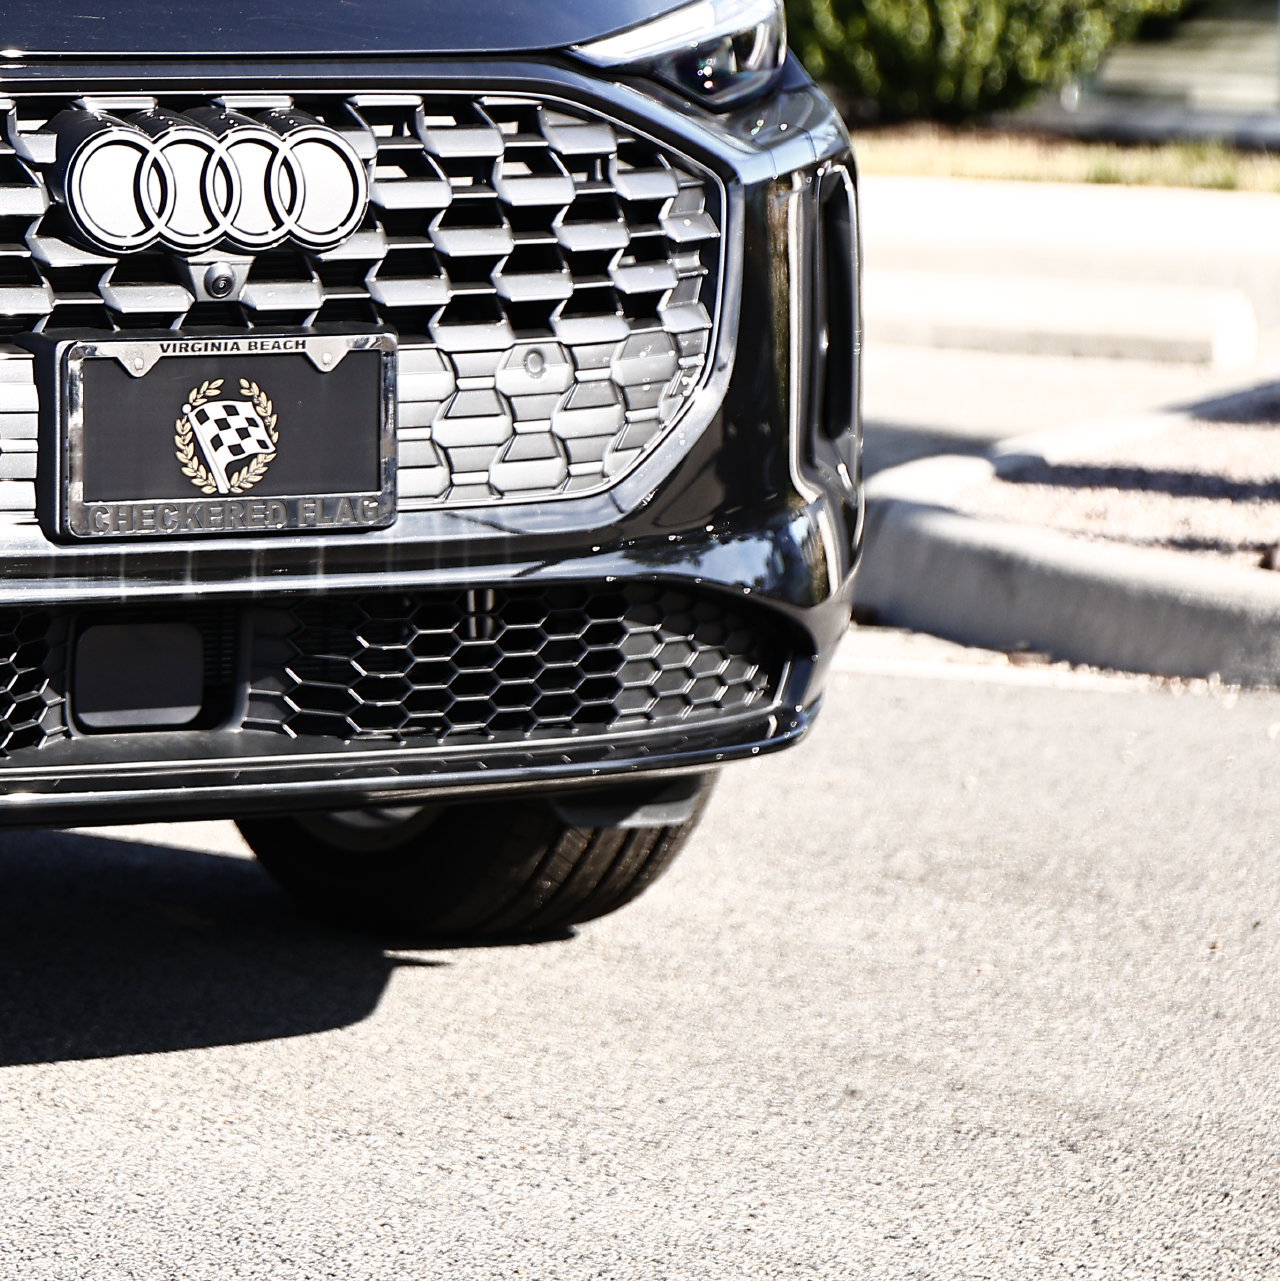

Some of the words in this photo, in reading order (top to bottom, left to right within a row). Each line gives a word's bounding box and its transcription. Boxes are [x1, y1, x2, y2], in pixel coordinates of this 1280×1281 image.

[158, 340, 242, 354] VIRGINIA
[247, 338, 308, 352] BEACH
[87, 499, 288, 536] CHECKERED
[298, 496, 381, 527] FLAG
